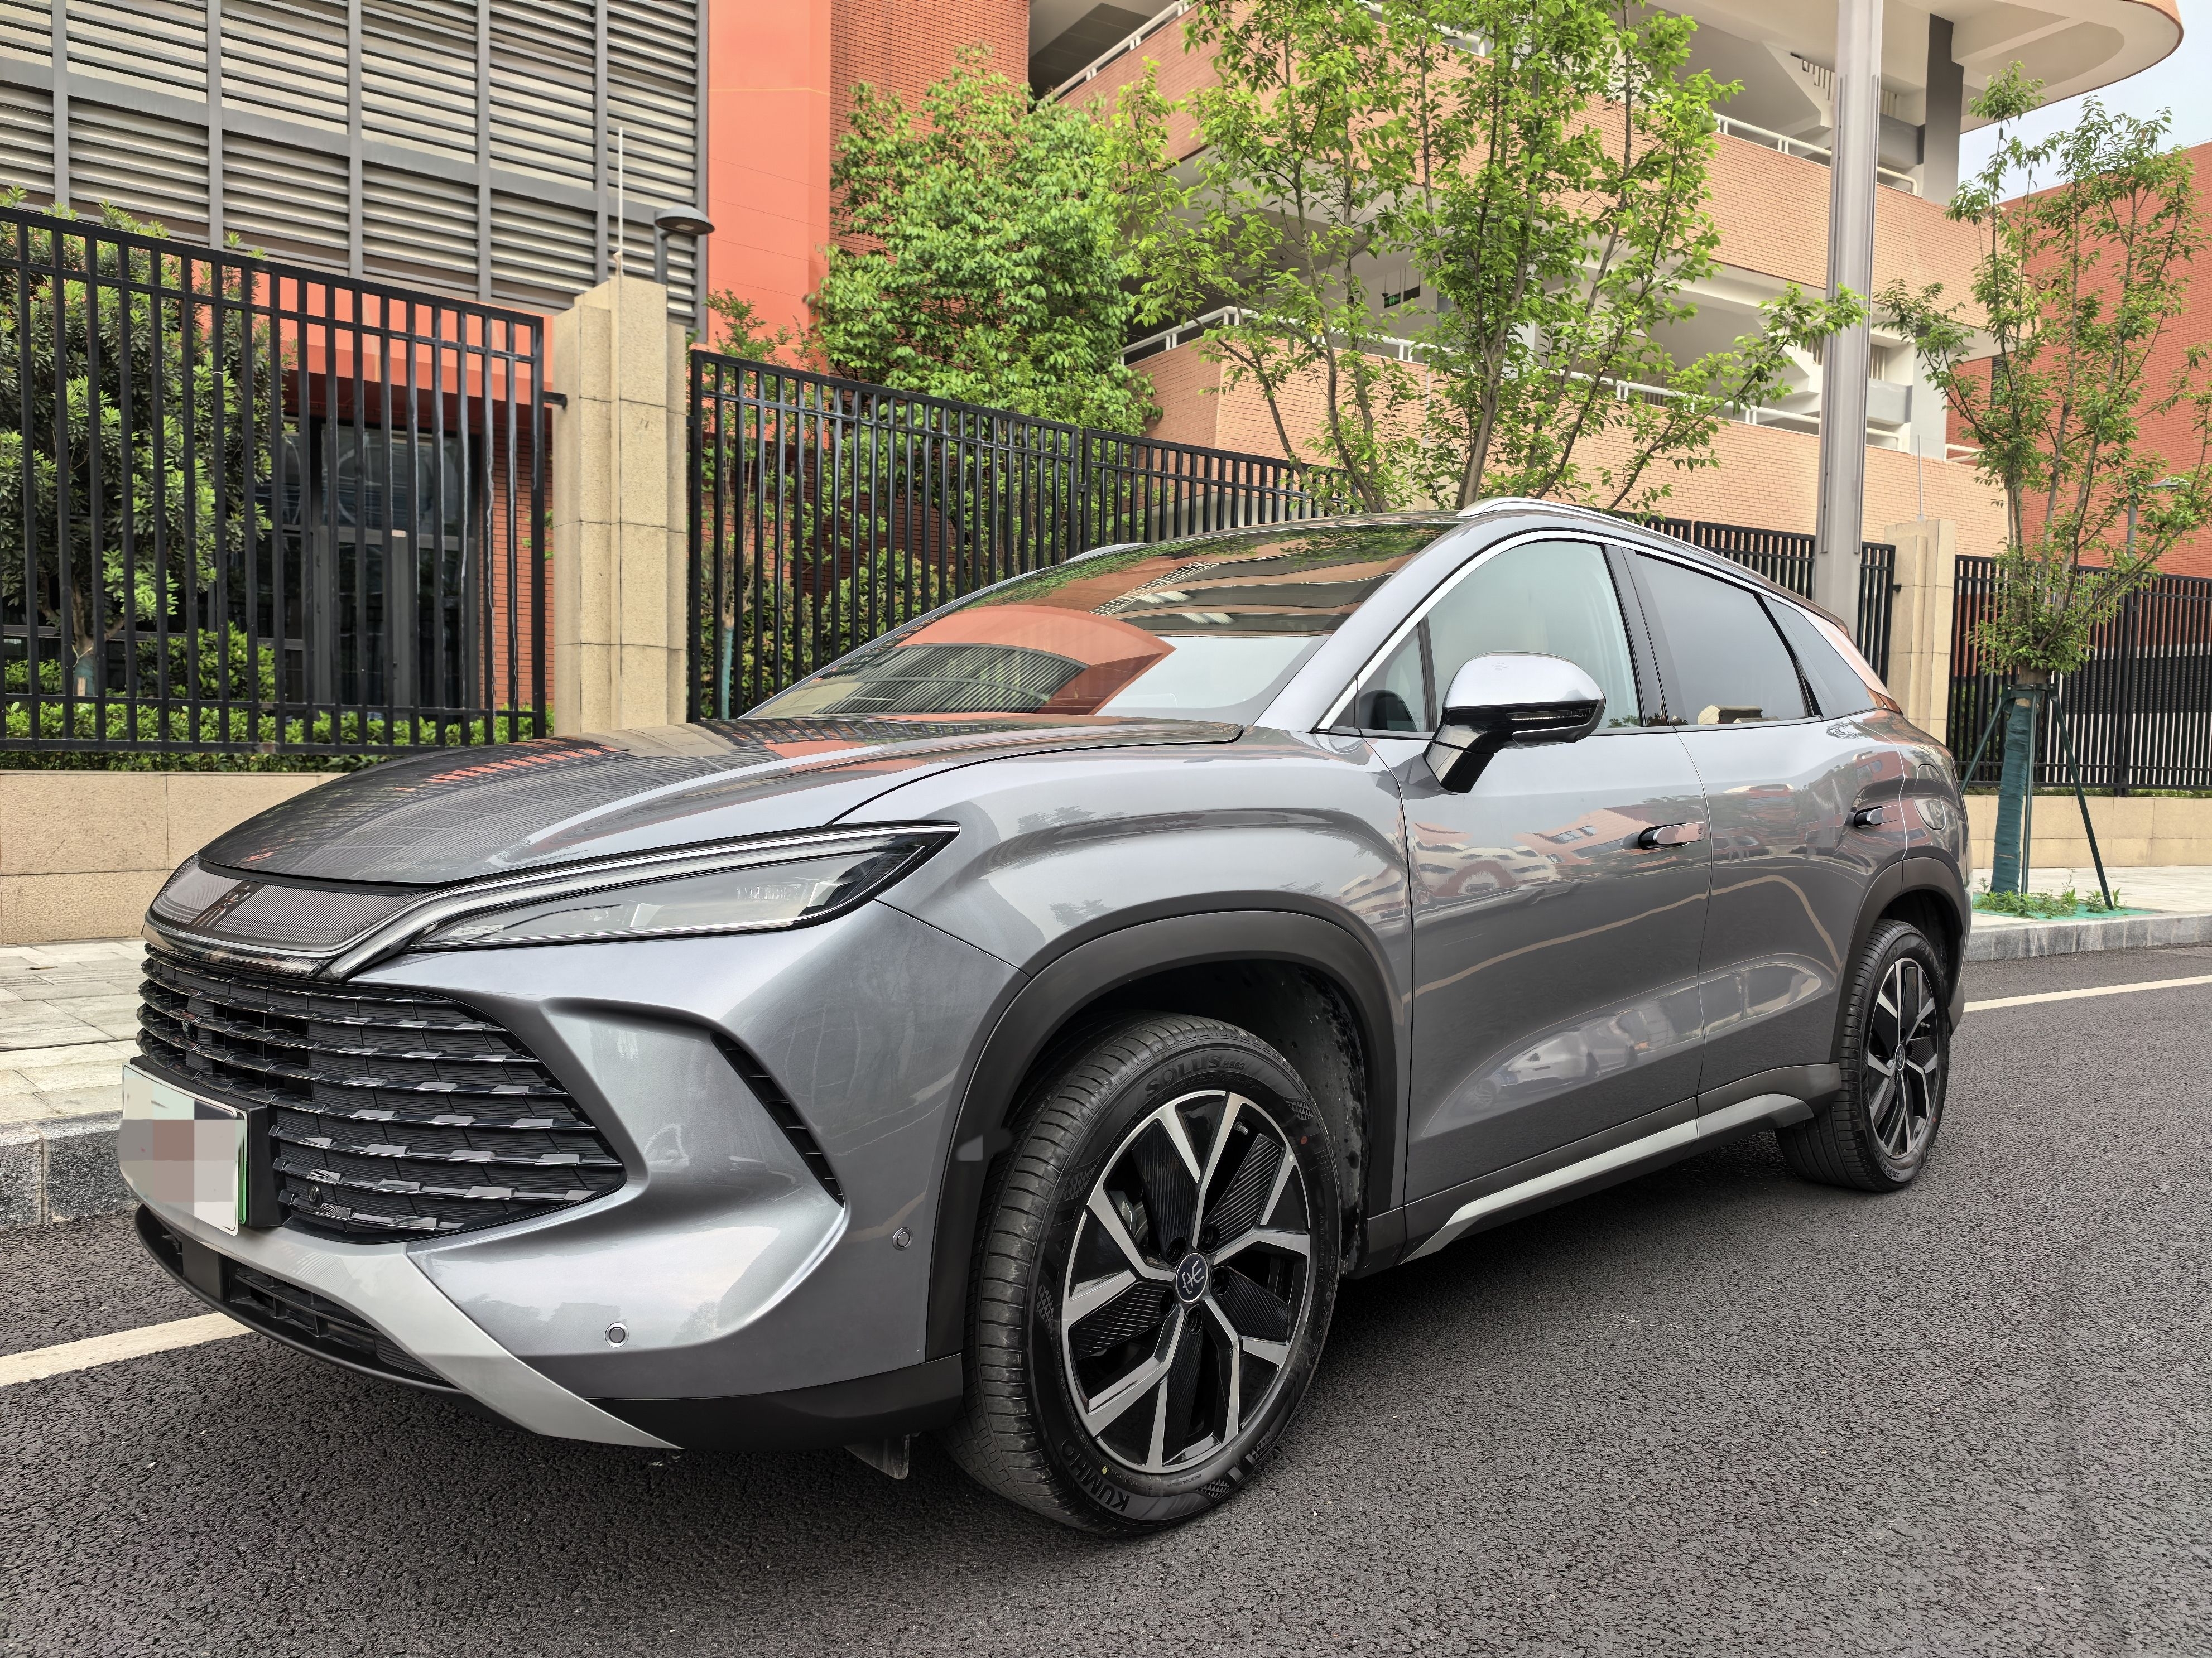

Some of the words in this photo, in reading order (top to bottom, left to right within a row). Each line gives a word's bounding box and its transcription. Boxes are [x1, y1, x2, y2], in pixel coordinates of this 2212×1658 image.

[1145, 1055, 1223, 1095] SOLUS
[1223, 1061, 1246, 1071] HS63
[1061, 1439, 1131, 1512] KUMHO
